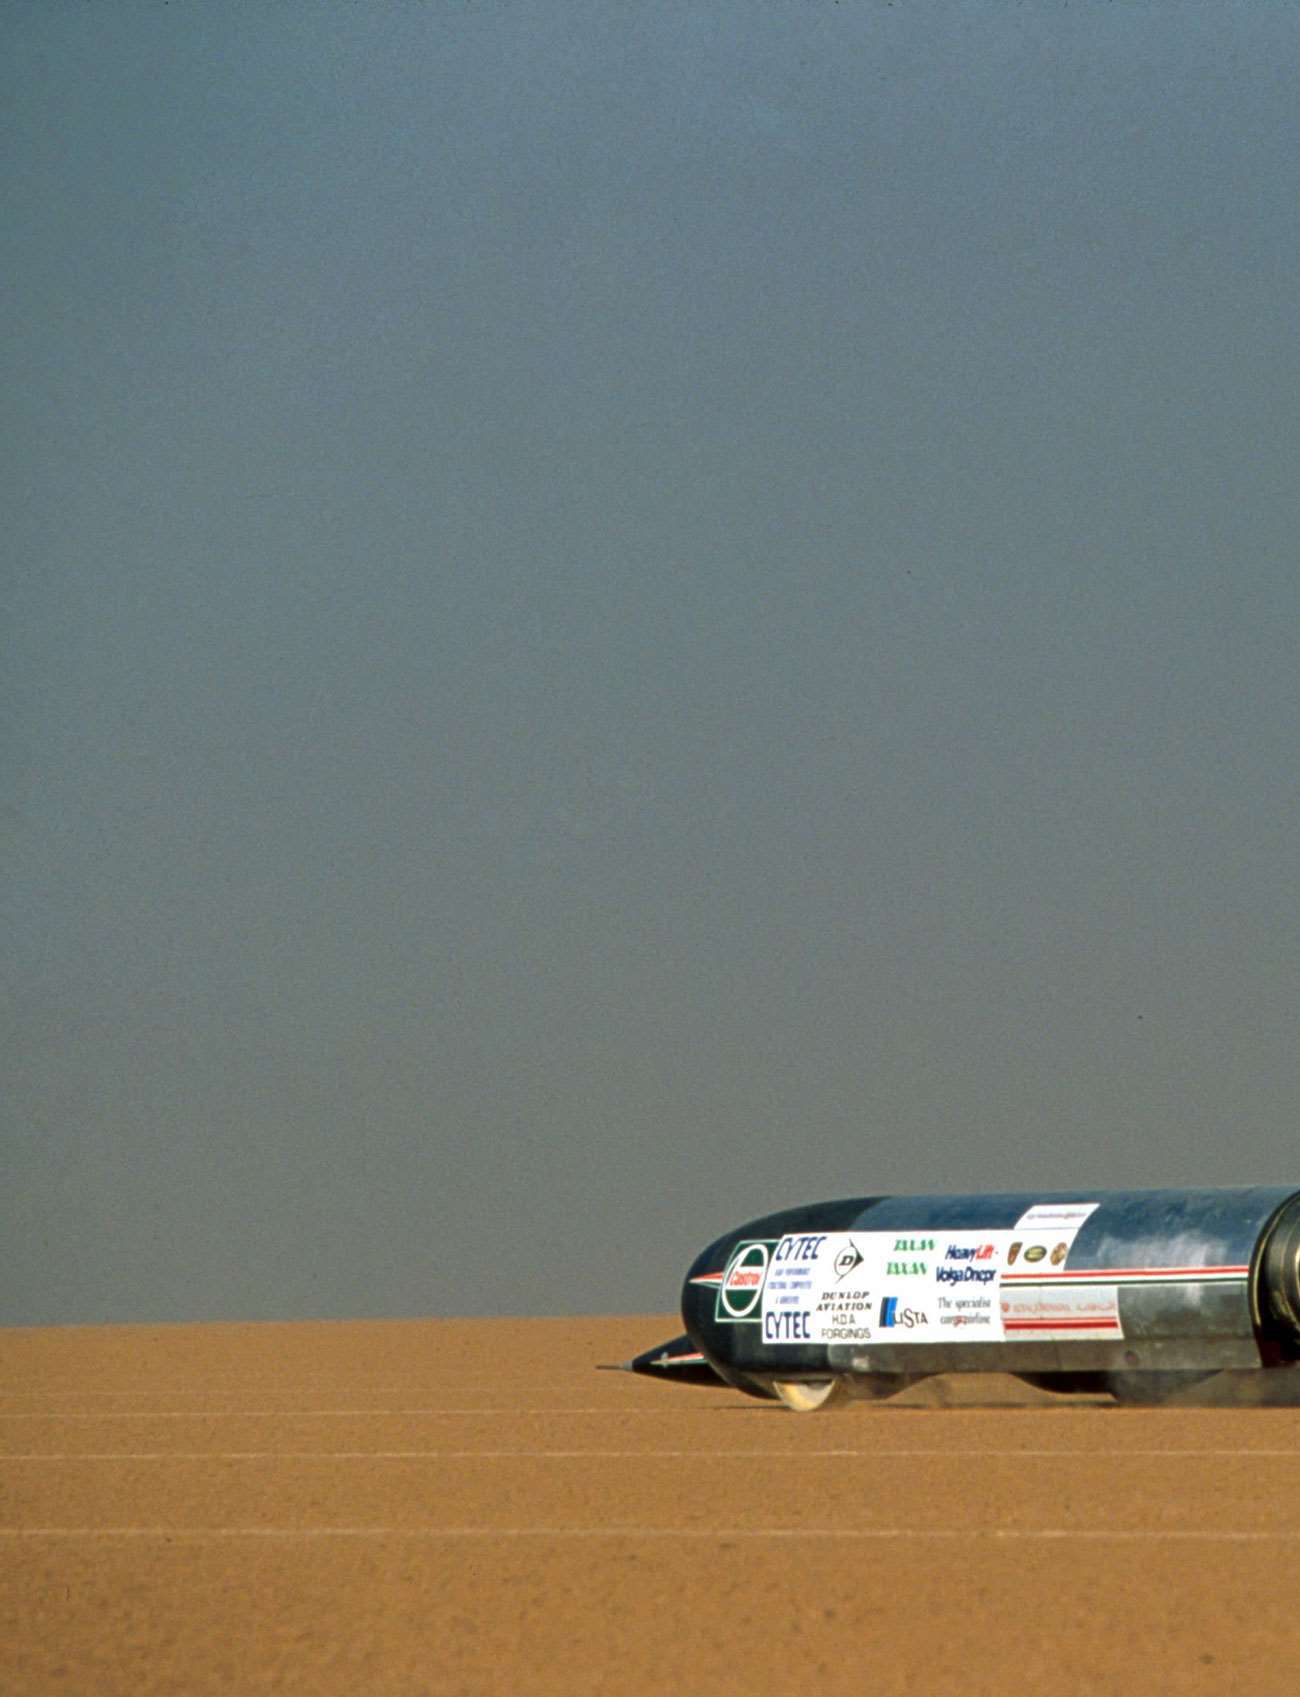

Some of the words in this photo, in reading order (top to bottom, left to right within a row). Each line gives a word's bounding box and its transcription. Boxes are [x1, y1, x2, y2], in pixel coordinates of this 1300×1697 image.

[775, 1236, 827, 1261] CYTEC
[729, 1271, 762, 1287] Castrol
[821, 1291, 870, 1301] DUNLOP
[816, 1302, 872, 1311] AVIATION
[765, 1311, 811, 1339] CYTEC
[894, 1308, 928, 1328] LISTA
[821, 1328, 872, 1339] FORGINGS
